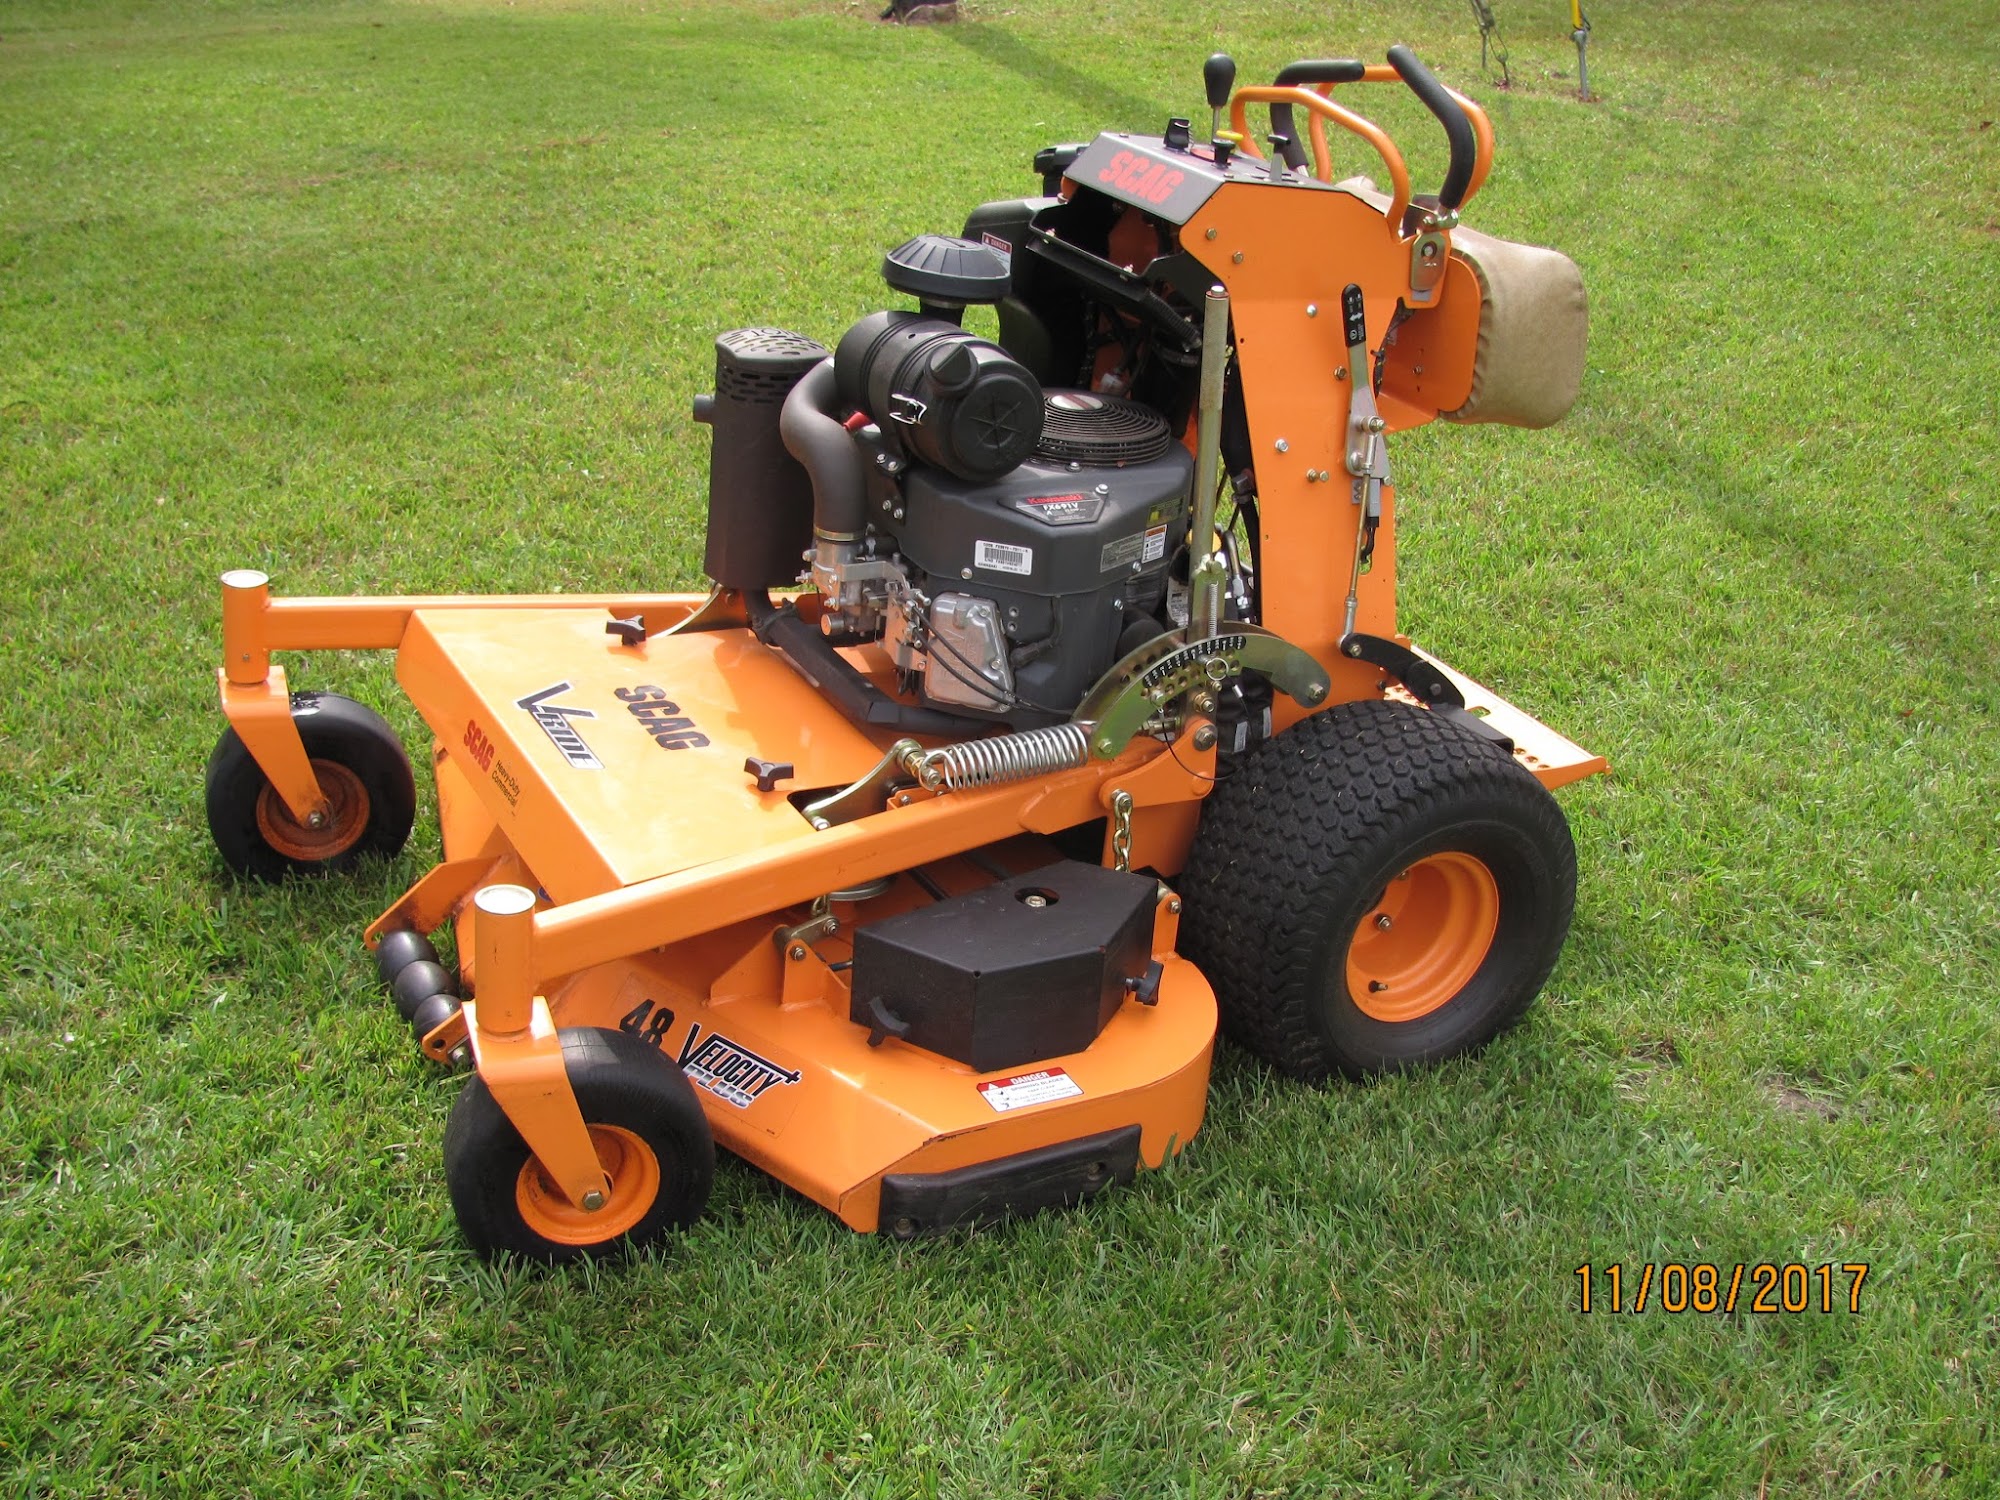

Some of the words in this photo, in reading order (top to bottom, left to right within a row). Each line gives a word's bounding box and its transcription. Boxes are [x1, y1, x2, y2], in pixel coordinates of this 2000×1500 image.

[1099, 150, 1184, 204] SCAG
[1043, 502, 1078, 511] FX691V
[614, 684, 711, 751] SCAG
[463, 719, 495, 773] SCAG
[491, 769, 518, 807] Commercial
[495, 759, 520, 797] Heavy-Duty
[619, 998, 675, 1048] 48
[682, 1065, 754, 1109] PLUS
[1010, 1071, 1050, 1085] DANGER
